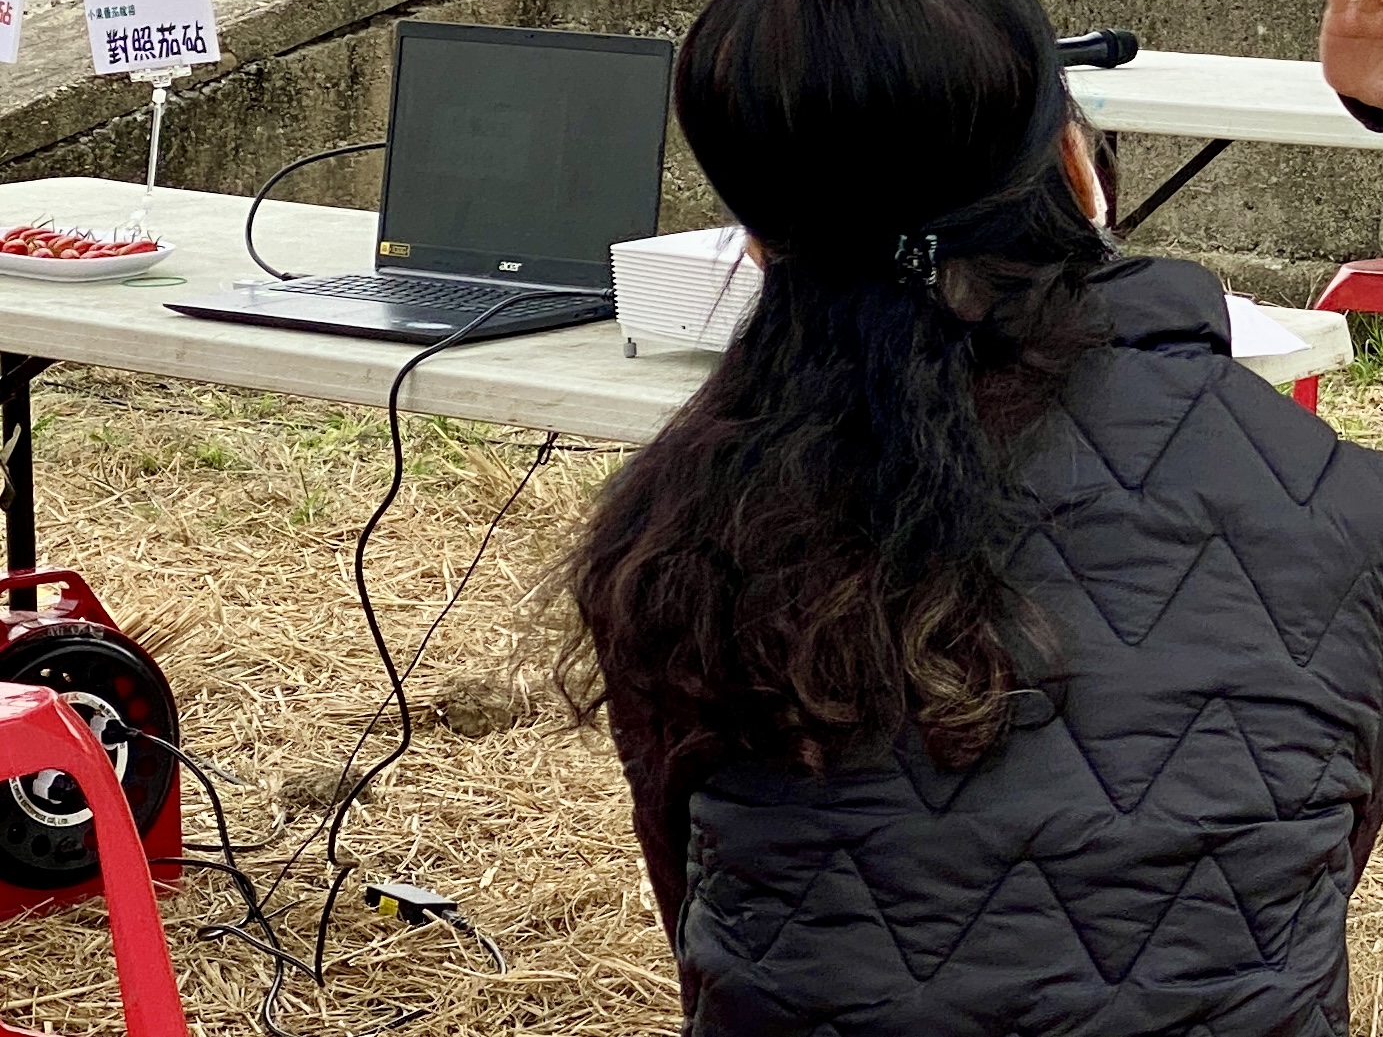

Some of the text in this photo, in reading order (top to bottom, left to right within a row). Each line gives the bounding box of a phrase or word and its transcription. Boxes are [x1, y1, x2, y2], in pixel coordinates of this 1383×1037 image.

[106, 20, 207, 64] 對照茄砧
[499, 261, 522, 272] acer
